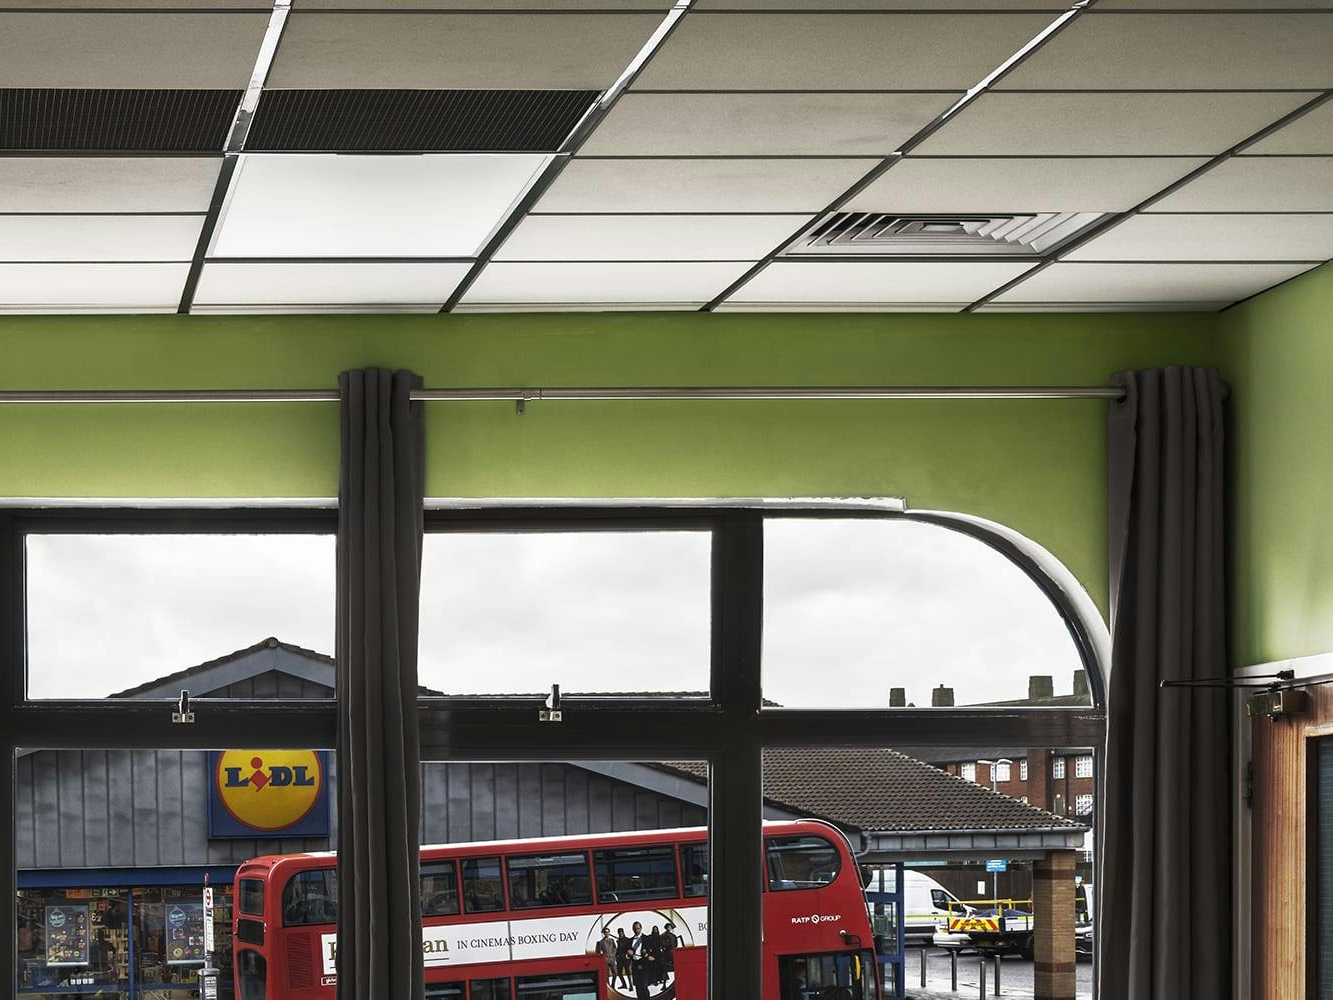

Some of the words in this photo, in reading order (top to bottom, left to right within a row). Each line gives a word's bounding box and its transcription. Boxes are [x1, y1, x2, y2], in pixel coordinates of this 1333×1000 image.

[791, 916, 810, 924] RATP
[819, 914, 841, 922] GROUP
[422, 939, 449, 953] an
[457, 940, 467, 949] IN
[470, 936, 515, 949] CINEMAS
[518, 933, 557, 945] BOXING
[560, 931, 579, 943] DAY
